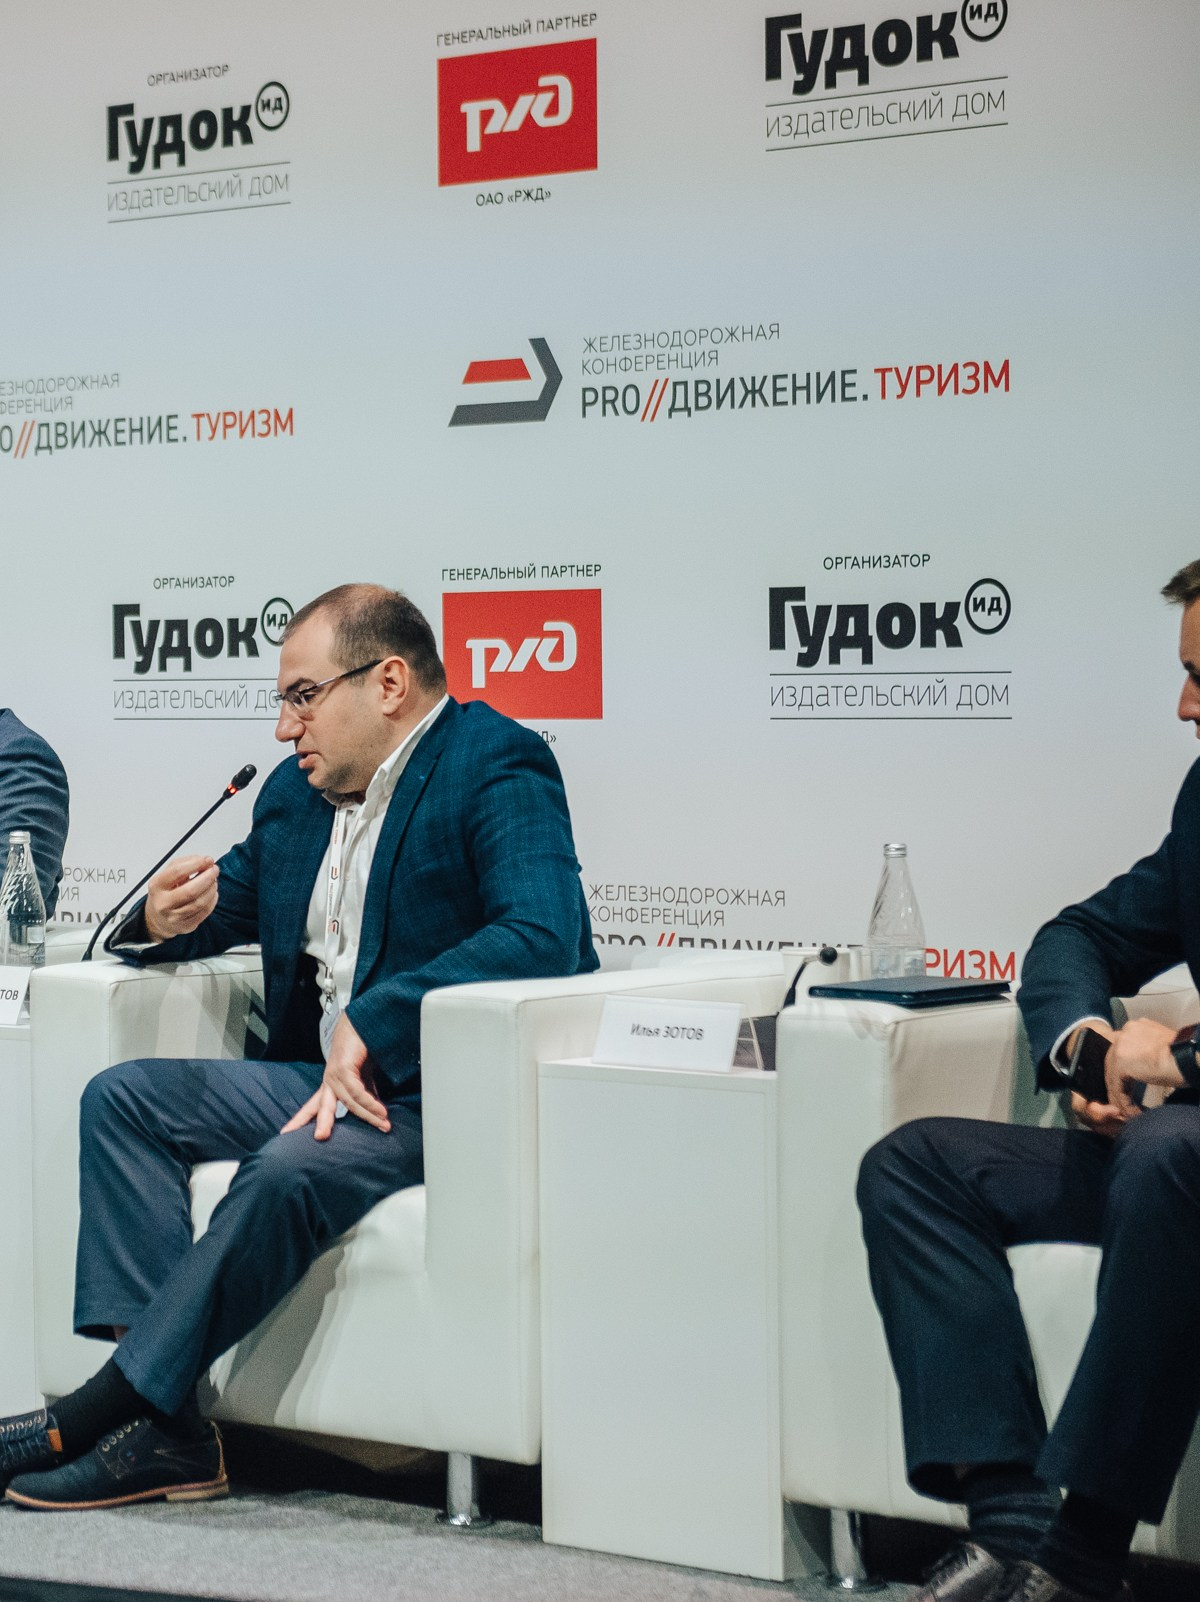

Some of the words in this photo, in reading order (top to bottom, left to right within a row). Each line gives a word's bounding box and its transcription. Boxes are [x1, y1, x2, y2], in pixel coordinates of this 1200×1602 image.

[436, 19, 532, 47] ГЕНЕРАЛЬНЫЙ
[536, 13, 598, 33] ПАРТНЕР
[765, 11, 960, 96] Гудок
[147, 64, 229, 87] ОРГАНИЗАТОР
[766, 90, 944, 140] издательский
[951, 89, 1006, 122] дом
[106, 102, 253, 174] Гудок
[107, 173, 242, 214] издательский
[248, 173, 289, 200] дом
[475, 191, 504, 207] ОАО
[507, 187, 552, 204] «РЖД»
[582, 323, 781, 355] ЖЕЛЕЗНОДОРОЖНАЯ
[581, 350, 719, 377] КОНФЕРЕНЦИЯ
[441, 563, 536, 581] ГЕНЕРАЛЬНЫЙ
[541, 564, 602, 579] ПАРТНЕР
[823, 553, 931, 570] ОРГАНИЗАТОР
[152, 575, 235, 590] ОРГАНИЗАТОР
[112, 603, 260, 675] Гудок
[769, 586, 964, 669] Гудок
[113, 684, 248, 713] издательский
[770, 678, 948, 711] издательский
[956, 684, 1010, 711] дом
[588, 883, 786, 907] ЖЕЛЕЗНОДОРОЖНАЯ
[630, 1023, 660, 1038] Илья
[662, 1025, 704, 1041] ЗОТОВ
